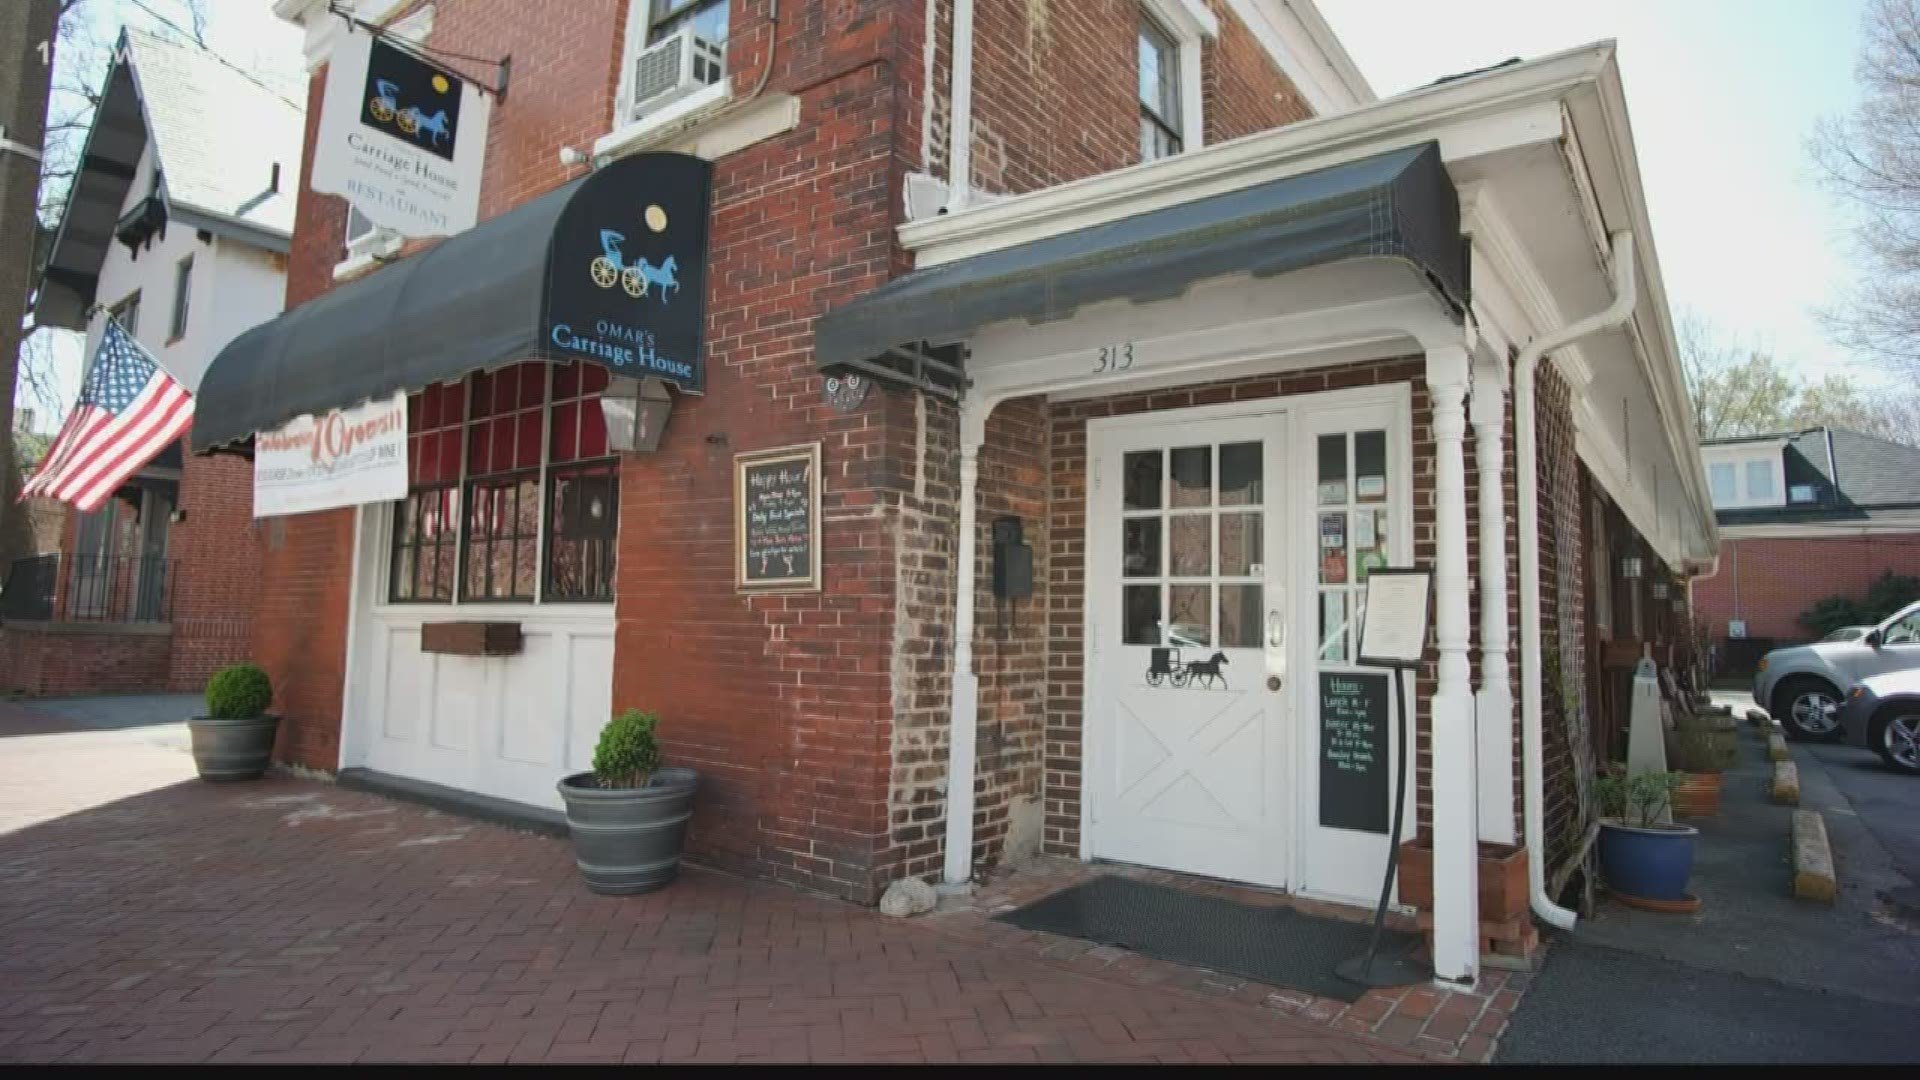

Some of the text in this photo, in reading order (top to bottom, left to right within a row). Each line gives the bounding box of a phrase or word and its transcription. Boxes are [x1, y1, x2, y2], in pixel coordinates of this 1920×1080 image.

[347, 132, 458, 191] Carriage House
[347, 179, 448, 229] RESTAURANT
[552, 324, 693, 378] Carriage House
[1092, 342, 1133, 373] 313
